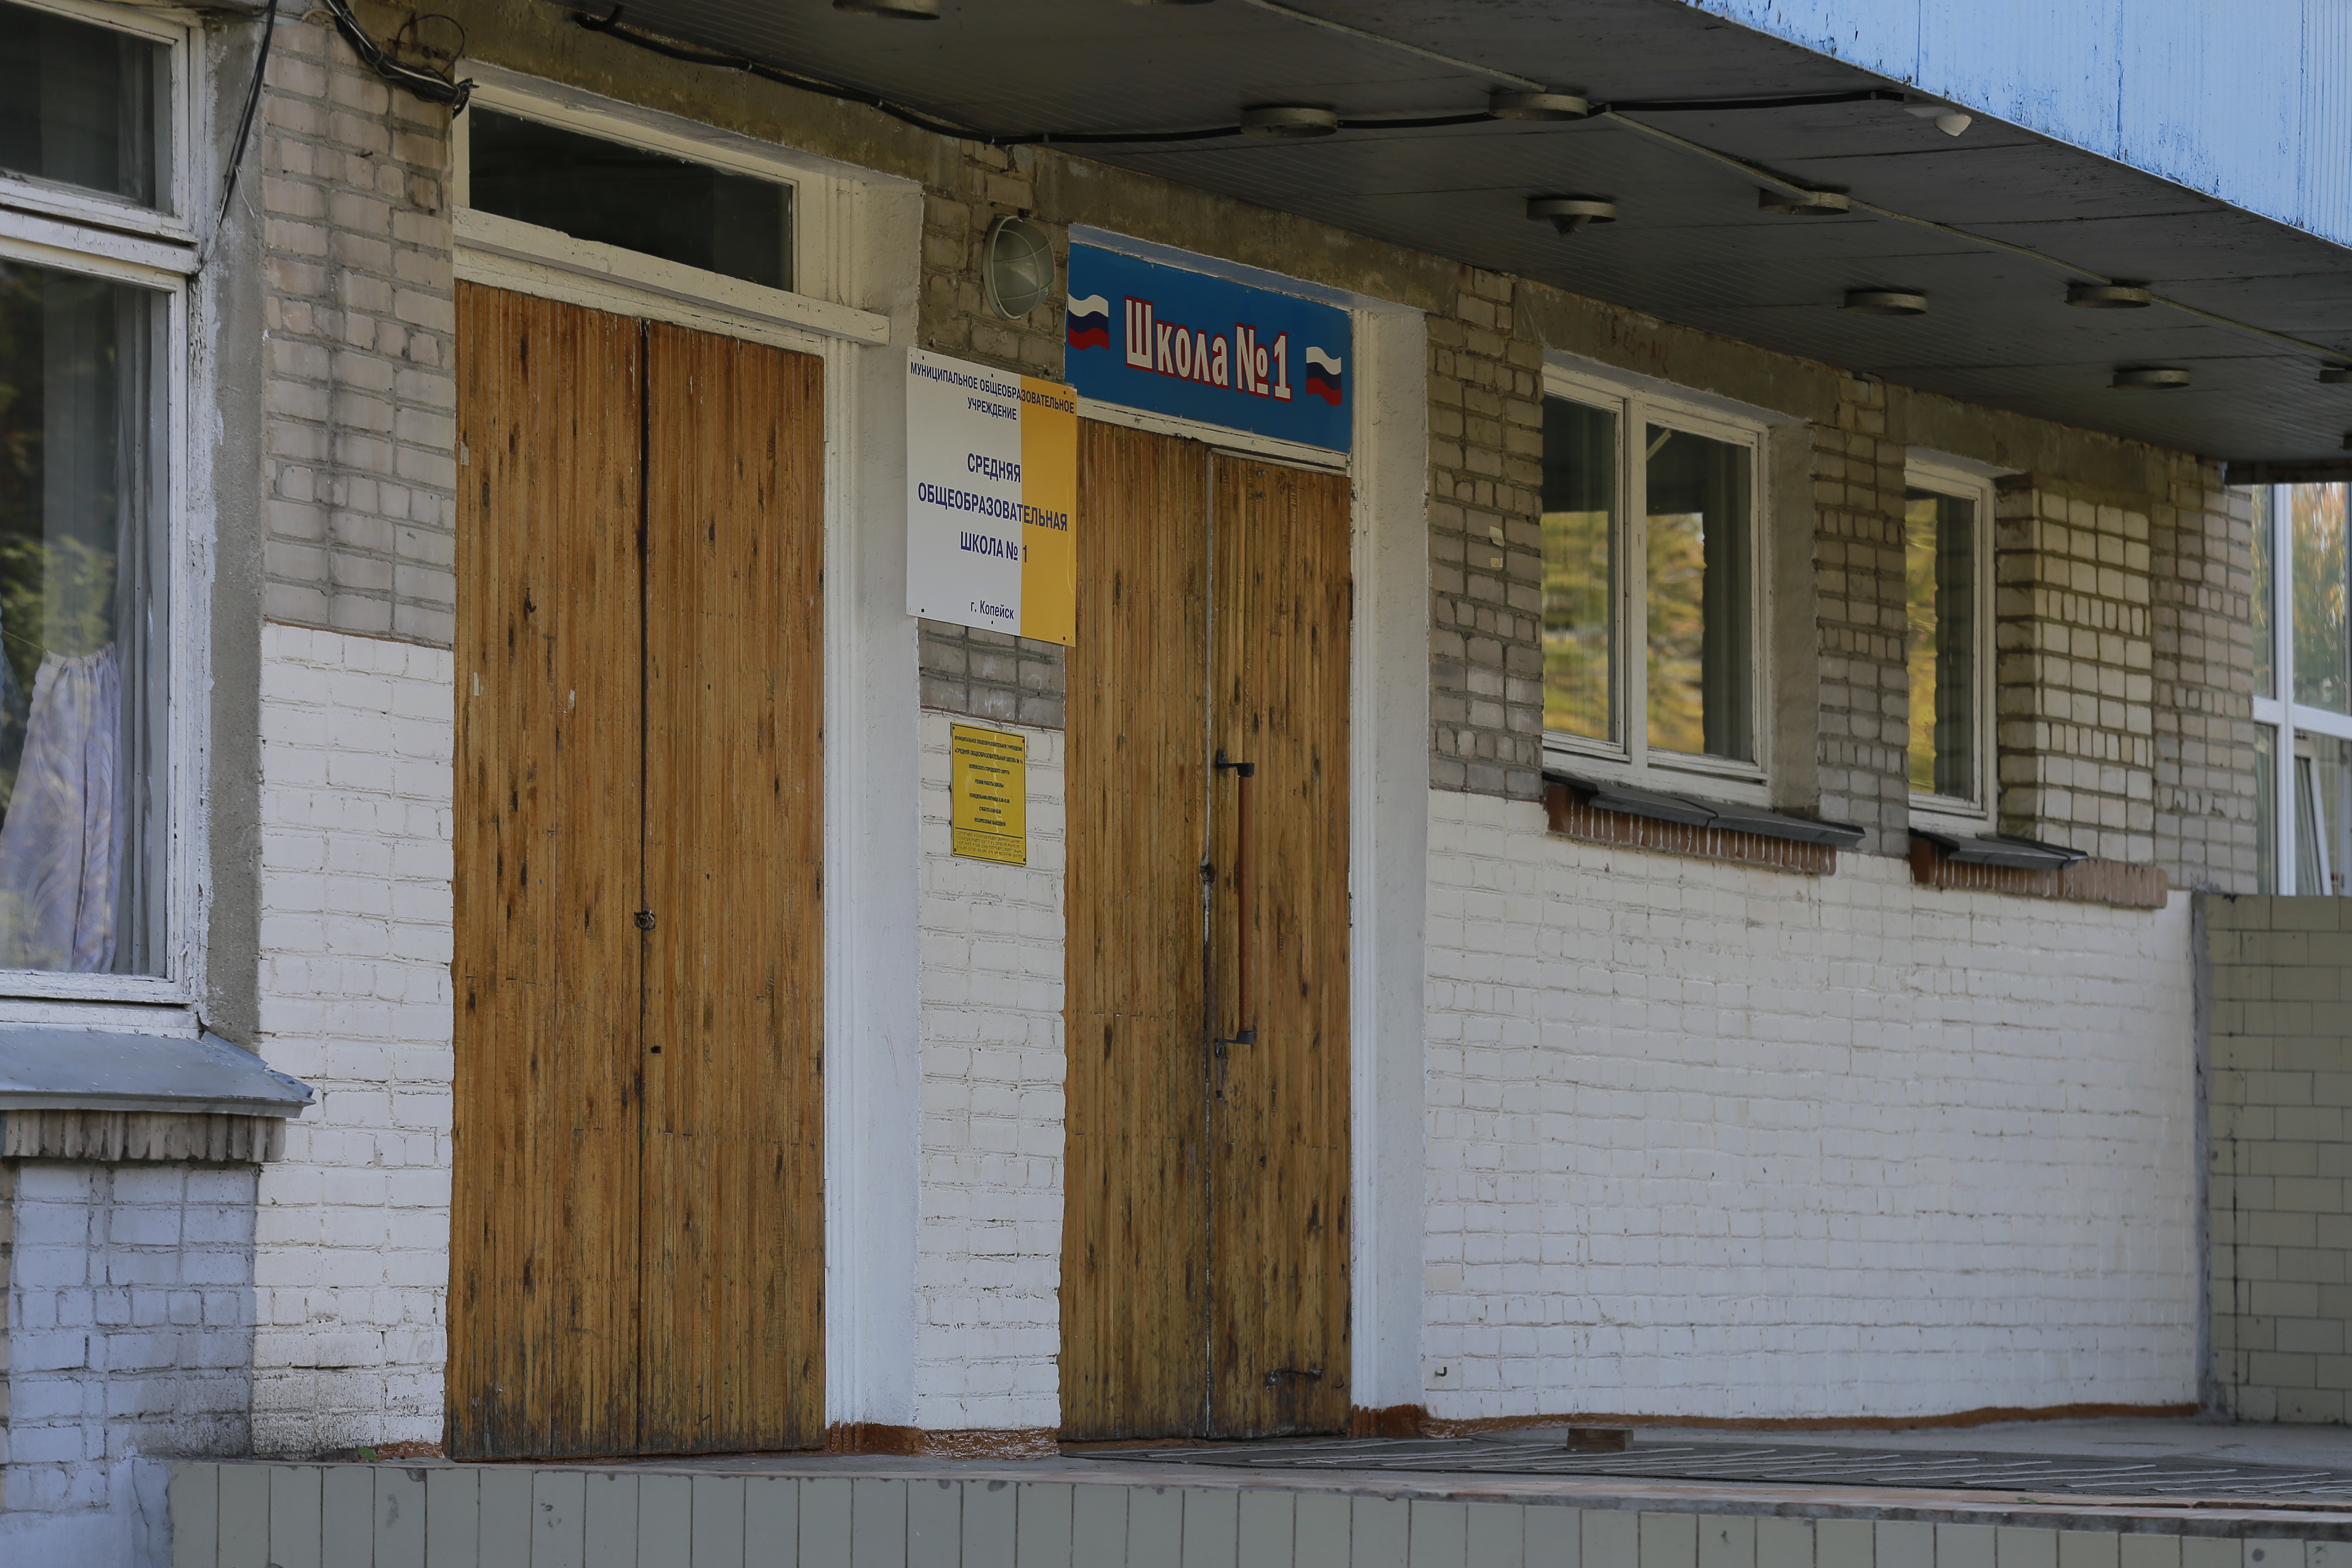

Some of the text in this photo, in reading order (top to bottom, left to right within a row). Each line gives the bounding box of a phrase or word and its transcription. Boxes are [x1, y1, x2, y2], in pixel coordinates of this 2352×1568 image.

[1125, 295, 1231, 390] Школа
[910, 361, 1074, 414] МУНИЦИПАЛЬНОЕ ОБЩЕОБРАЗОВАТЕЛЬНОЕ
[968, 397, 1017, 420] УЧРЕЖДЕНИЕ
[968, 453, 1021, 483] СРЕДНЯЯ
[918, 482, 1068, 532] ОБЩЕОБРАЗОВАТЕЛЬНАЯ
[961, 531, 1027, 563] ШКОЛА № 1
[971, 600, 1014, 619] г. Копейск
[970, 750, 1006, 761] ОБЩЕОБРАЗОВАТЕЛЬНАЯ
